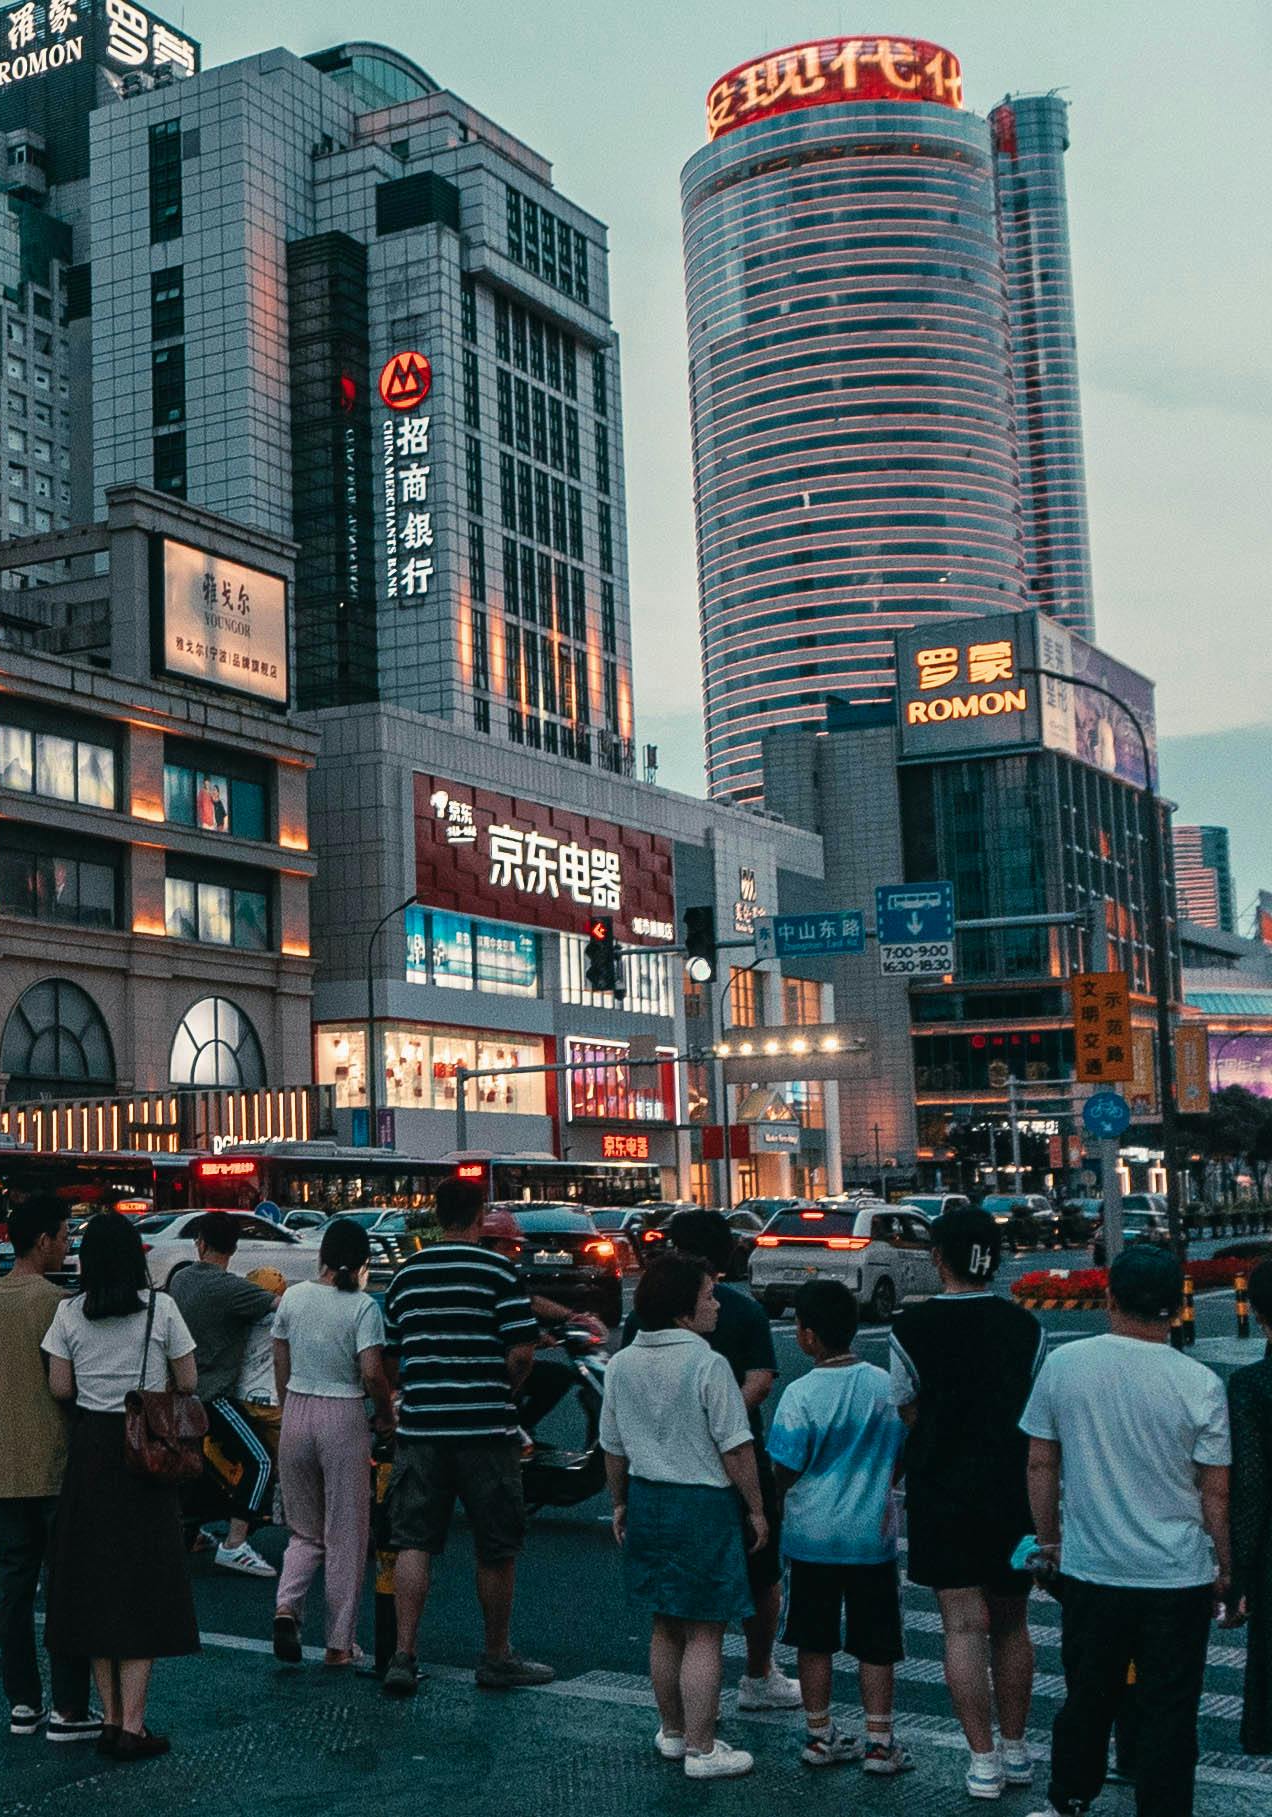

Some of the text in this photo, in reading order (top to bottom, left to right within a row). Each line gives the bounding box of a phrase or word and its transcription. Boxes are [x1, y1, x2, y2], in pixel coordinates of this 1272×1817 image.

[383, 420, 398, 598] CHINA MERCHANTS BANK
[396, 416, 434, 596] 招商銀行
[202, 572, 251, 616] 雅戈尔
[204, 611, 251, 638] YOUNGOR
[916, 640, 1014, 690] 罗蒙
[907, 688, 1027, 726] ROMON
[448, 800, 473, 825] 京东
[488, 824, 621, 911] 京东电器
[758, 925, 772, 941] 东
[778, 918, 861, 941] 中山东路
[883, 944, 949, 958] 7:00-9:00
[883, 958, 952, 973] 16:30-18:30
[1080, 980, 1103, 1075] 文明交通
[602, 1134, 649, 1158] 京东电器
